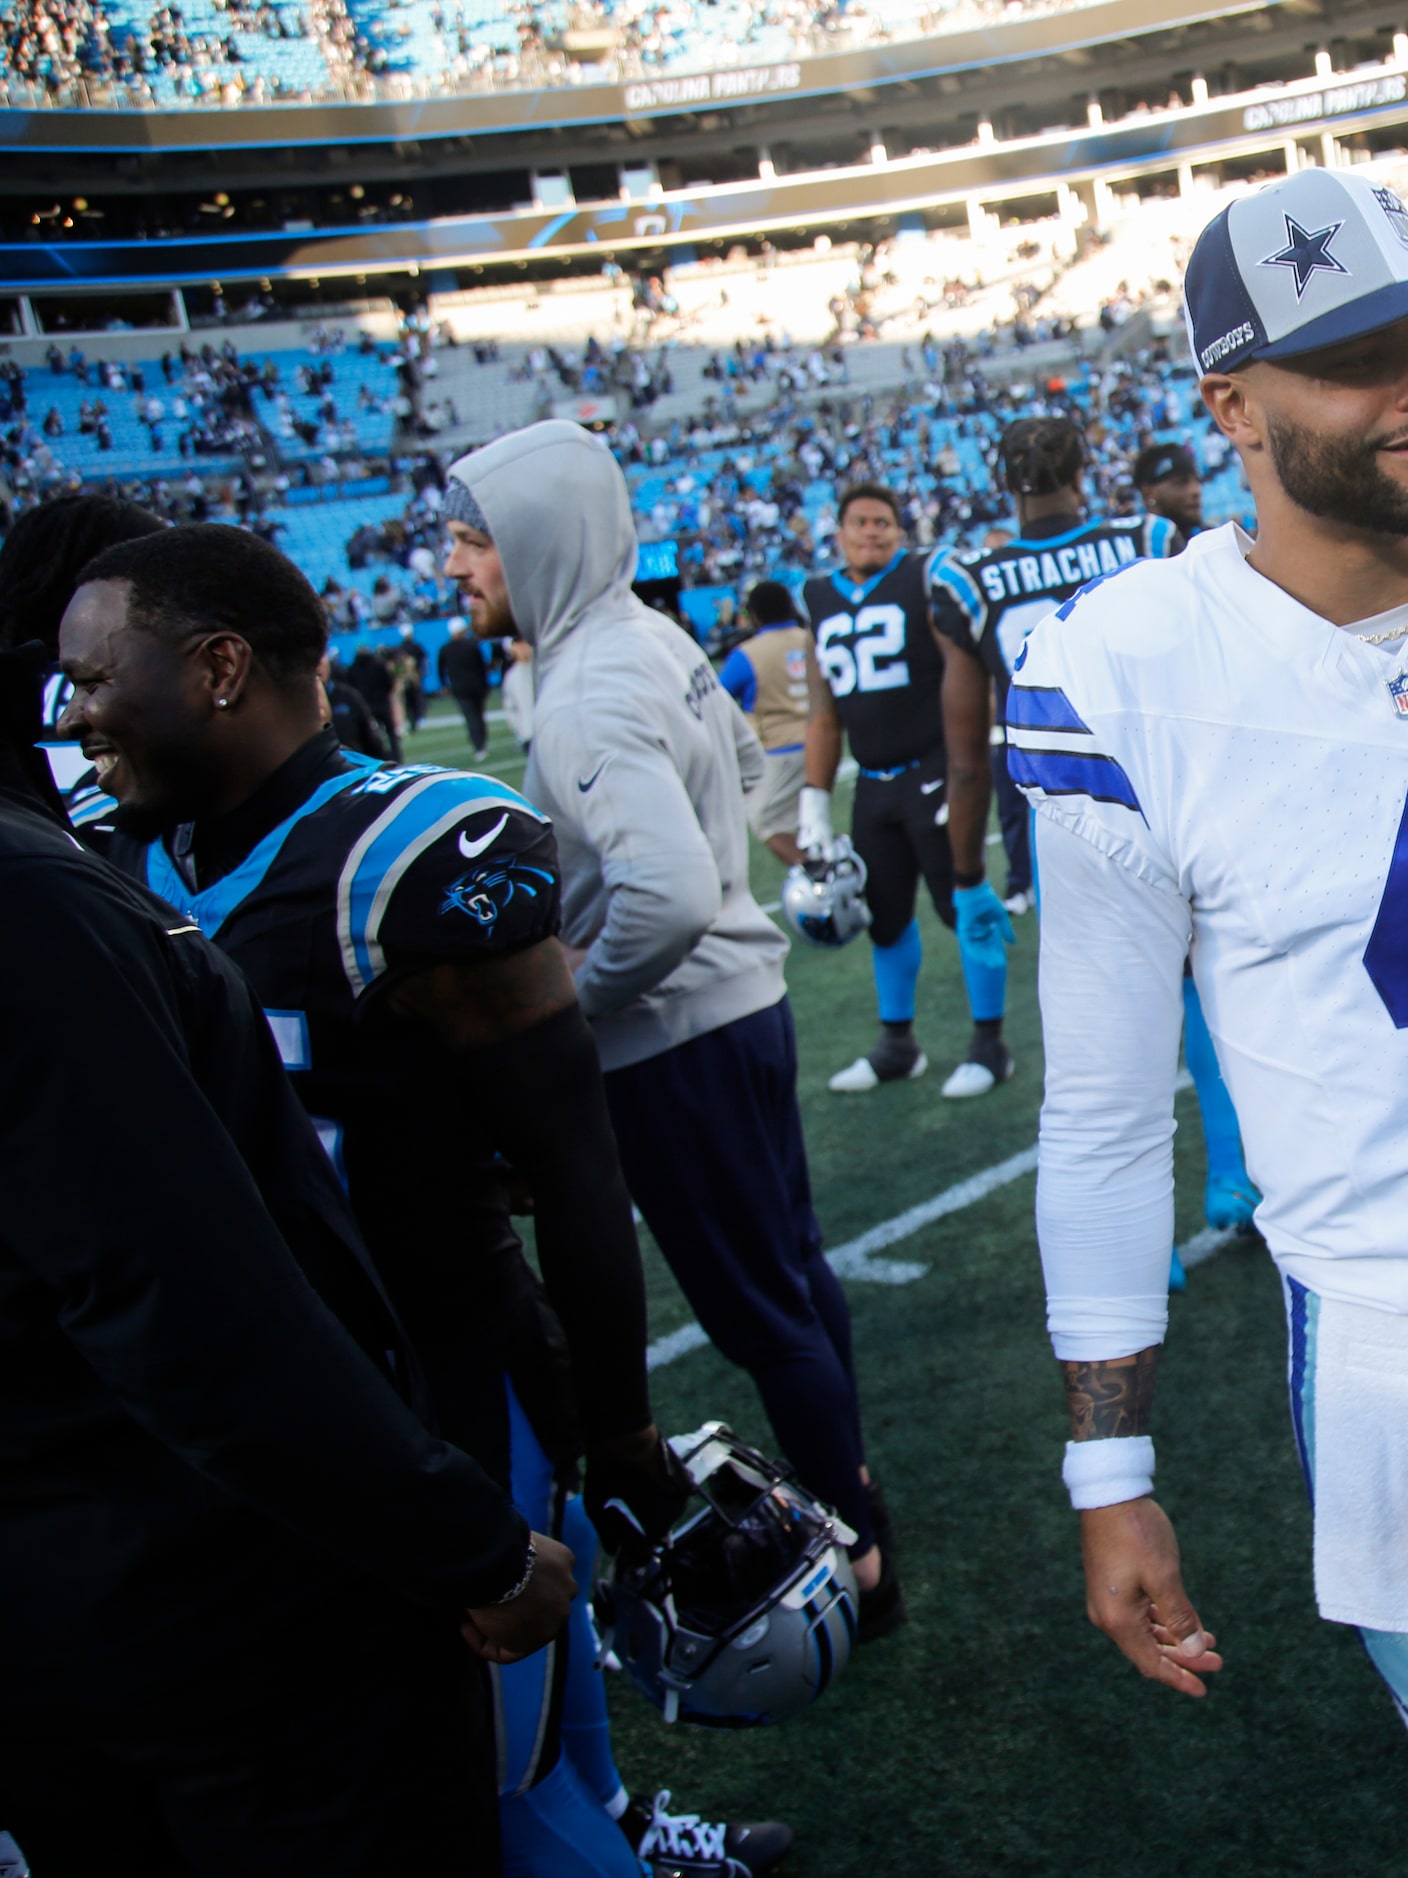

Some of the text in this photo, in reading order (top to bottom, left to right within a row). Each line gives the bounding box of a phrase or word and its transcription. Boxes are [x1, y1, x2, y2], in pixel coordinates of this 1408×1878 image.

[1201, 321, 1254, 369] COWBOYS
[981, 536, 1136, 600] STRACHAN
[815, 604, 910, 697] 62
